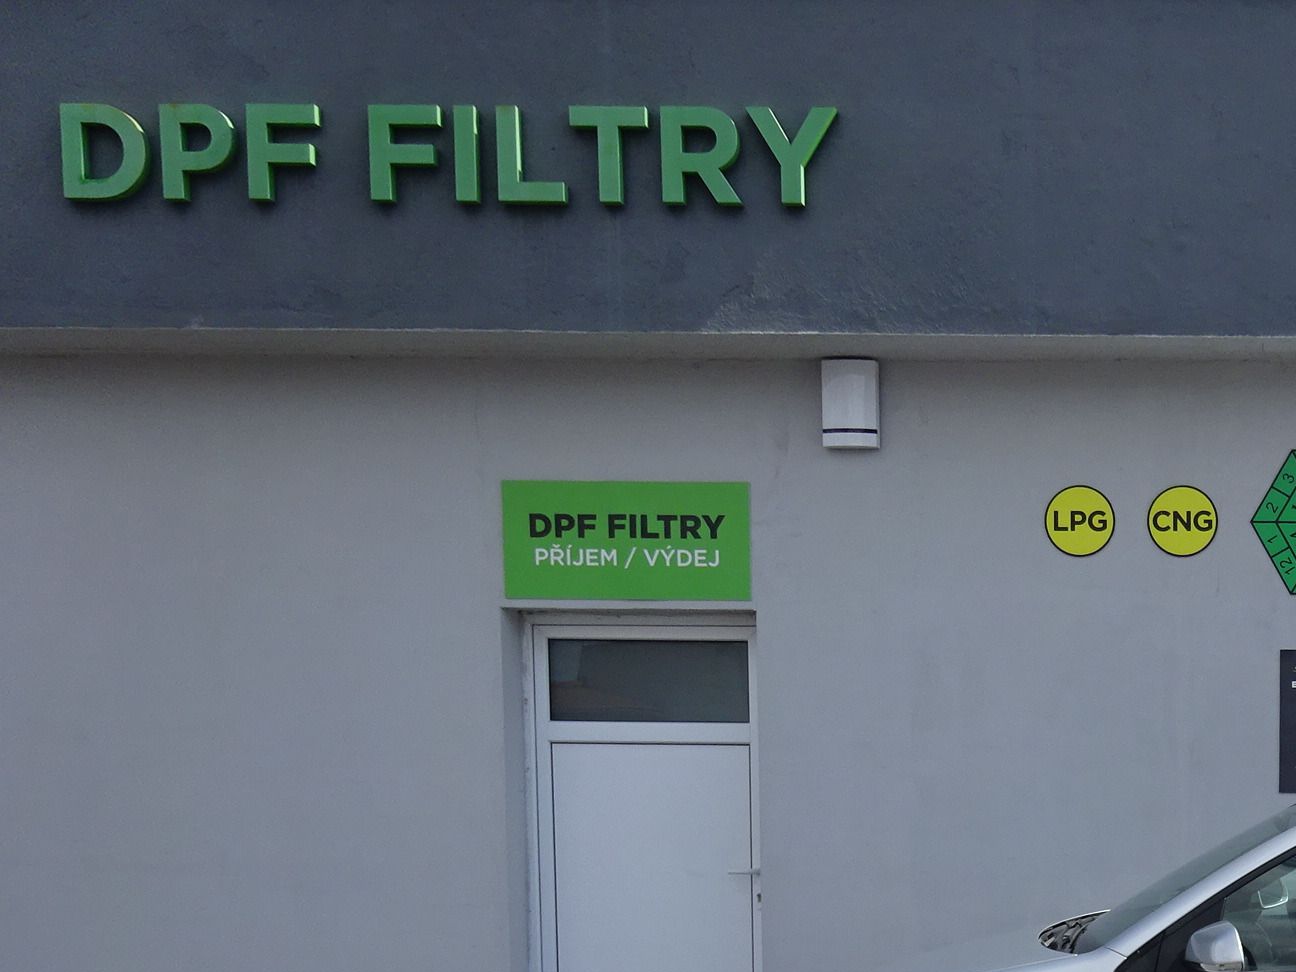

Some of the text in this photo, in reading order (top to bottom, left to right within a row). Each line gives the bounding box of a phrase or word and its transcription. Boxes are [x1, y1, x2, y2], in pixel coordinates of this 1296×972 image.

[58, 103, 840, 207] DPF FILTRY
[1282, 472, 1295, 484] 3
[1265, 501, 1279, 514] 2
[528, 513, 726, 540] DPF FILTRY
[1053, 510, 1108, 532] LPG
[1152, 510, 1213, 532] CNG
[1267, 534, 1278, 544] 1
[535, 544, 720, 569] PŘÍJEM / VÝDEJ
[1279, 556, 1296, 575] 12
